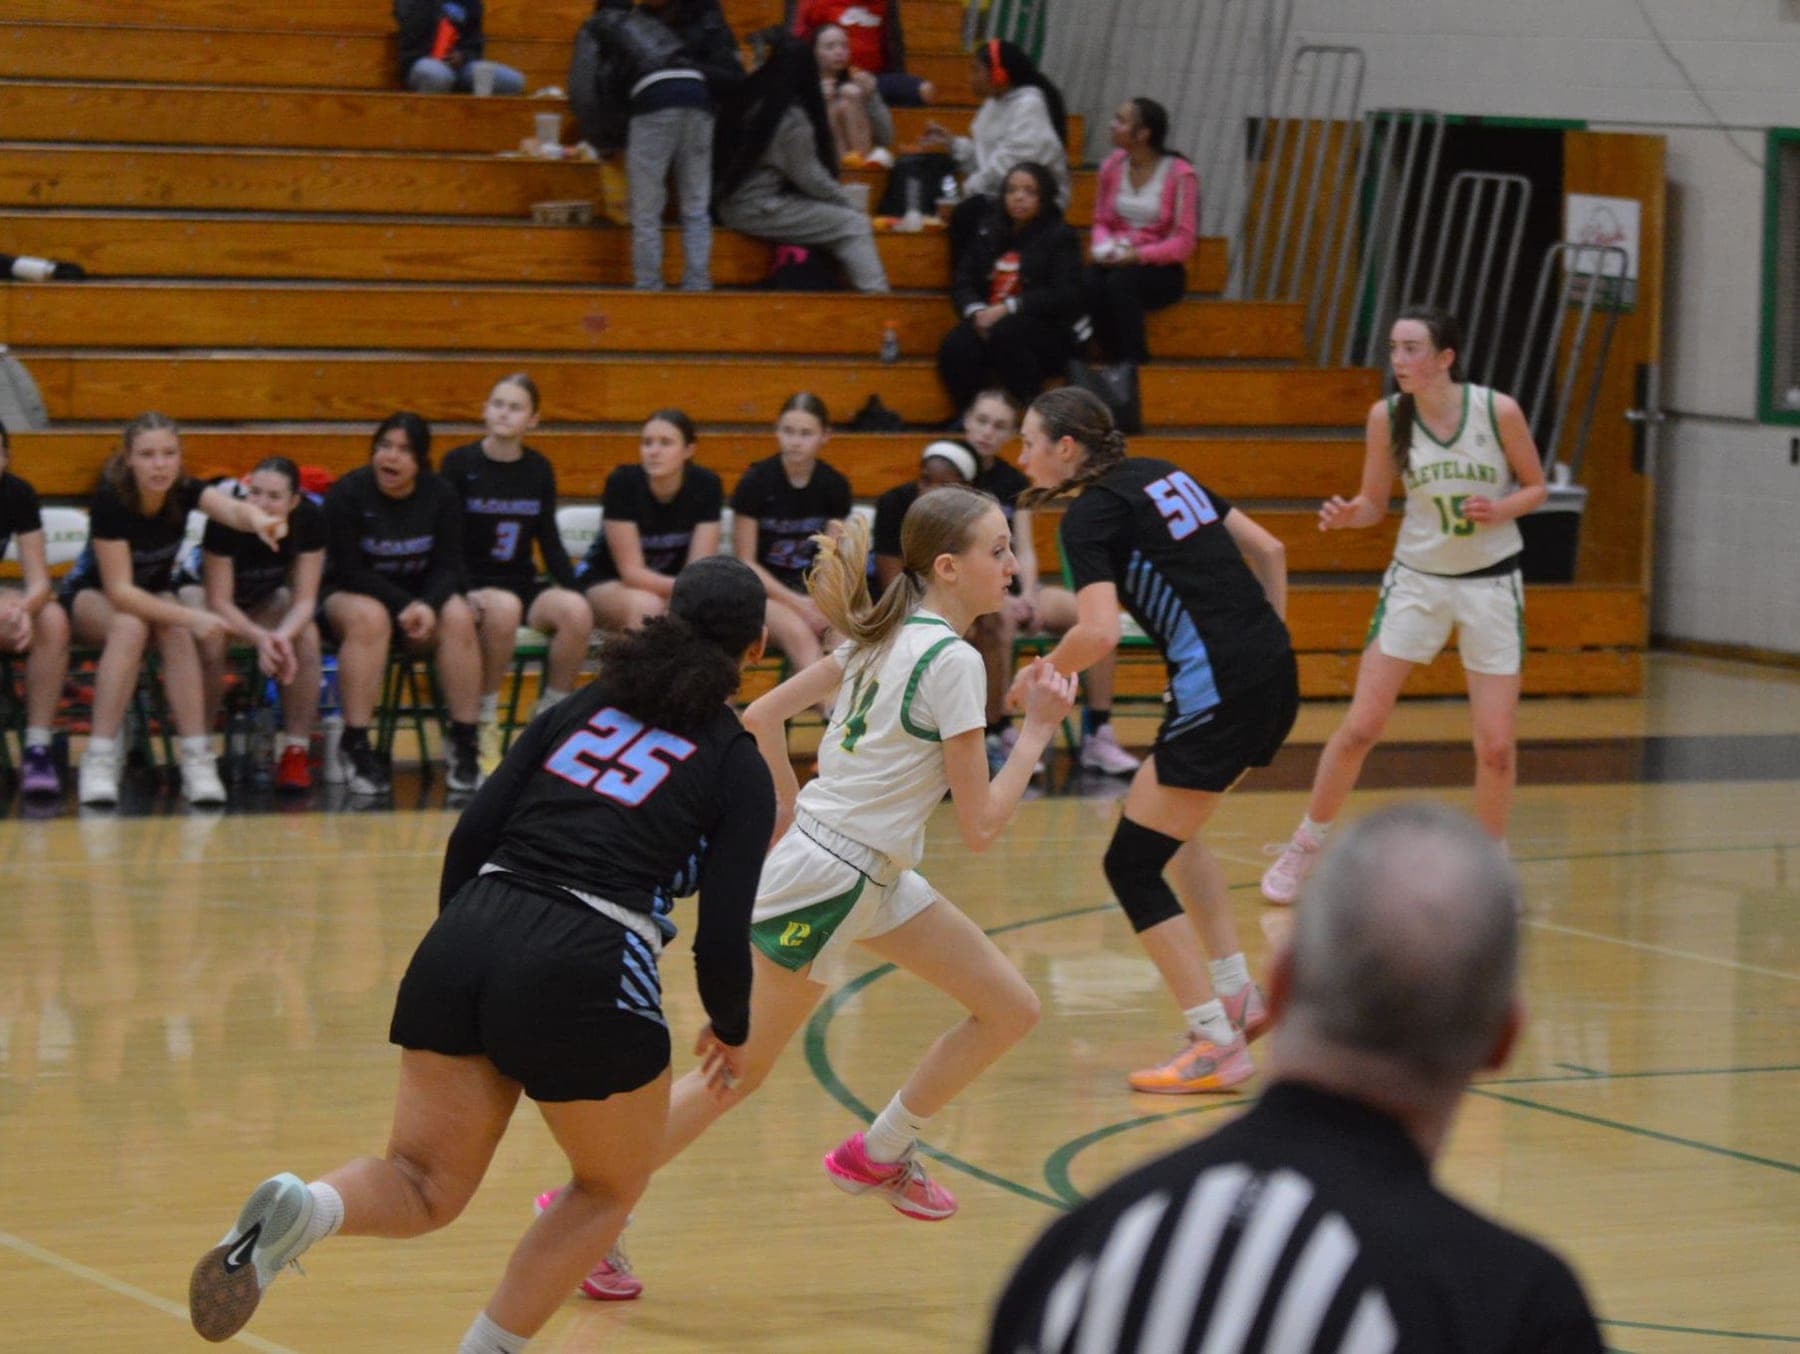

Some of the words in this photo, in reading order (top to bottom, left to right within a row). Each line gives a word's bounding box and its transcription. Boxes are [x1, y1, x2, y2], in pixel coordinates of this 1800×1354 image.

[1142, 469, 1219, 541] 50
[1431, 494, 1476, 536] 15
[490, 520, 521, 562] 3
[544, 706, 698, 807] 25
